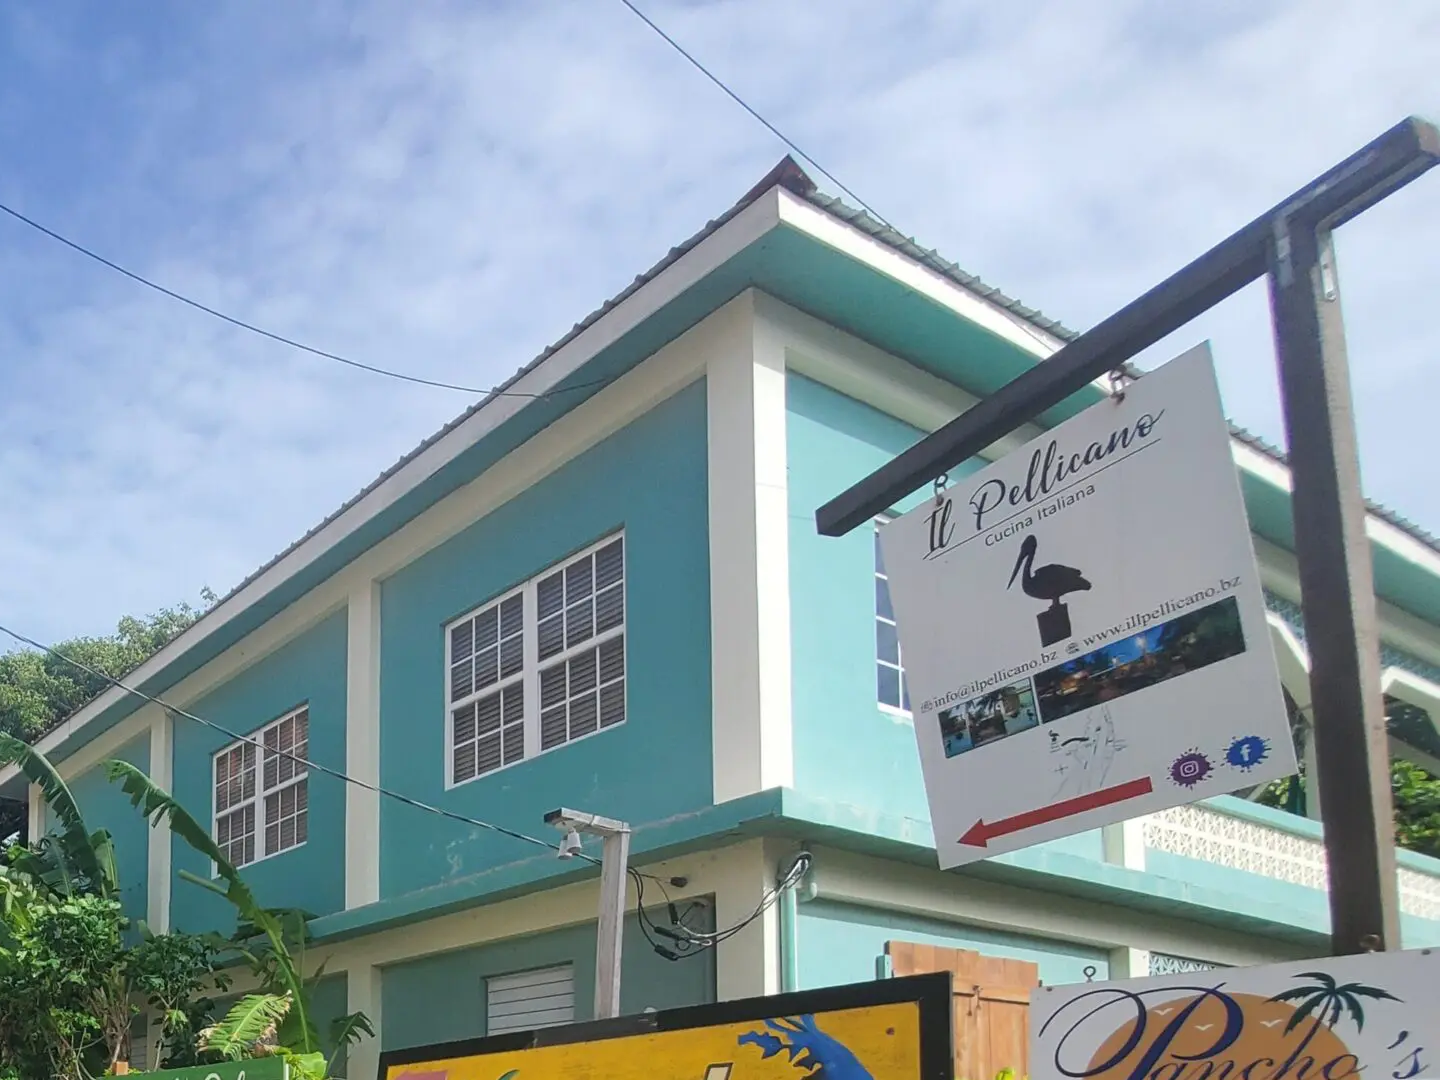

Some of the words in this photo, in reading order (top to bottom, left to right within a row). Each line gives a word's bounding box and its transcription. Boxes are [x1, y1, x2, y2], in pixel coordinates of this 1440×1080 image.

[923, 498, 956, 560] Il
[969, 408, 1166, 531] Pellicano
[984, 515, 1034, 547] Cucina
[1037, 482, 1096, 521] Italiana
[934, 650, 1058, 710] info@ilpellicano.bz
